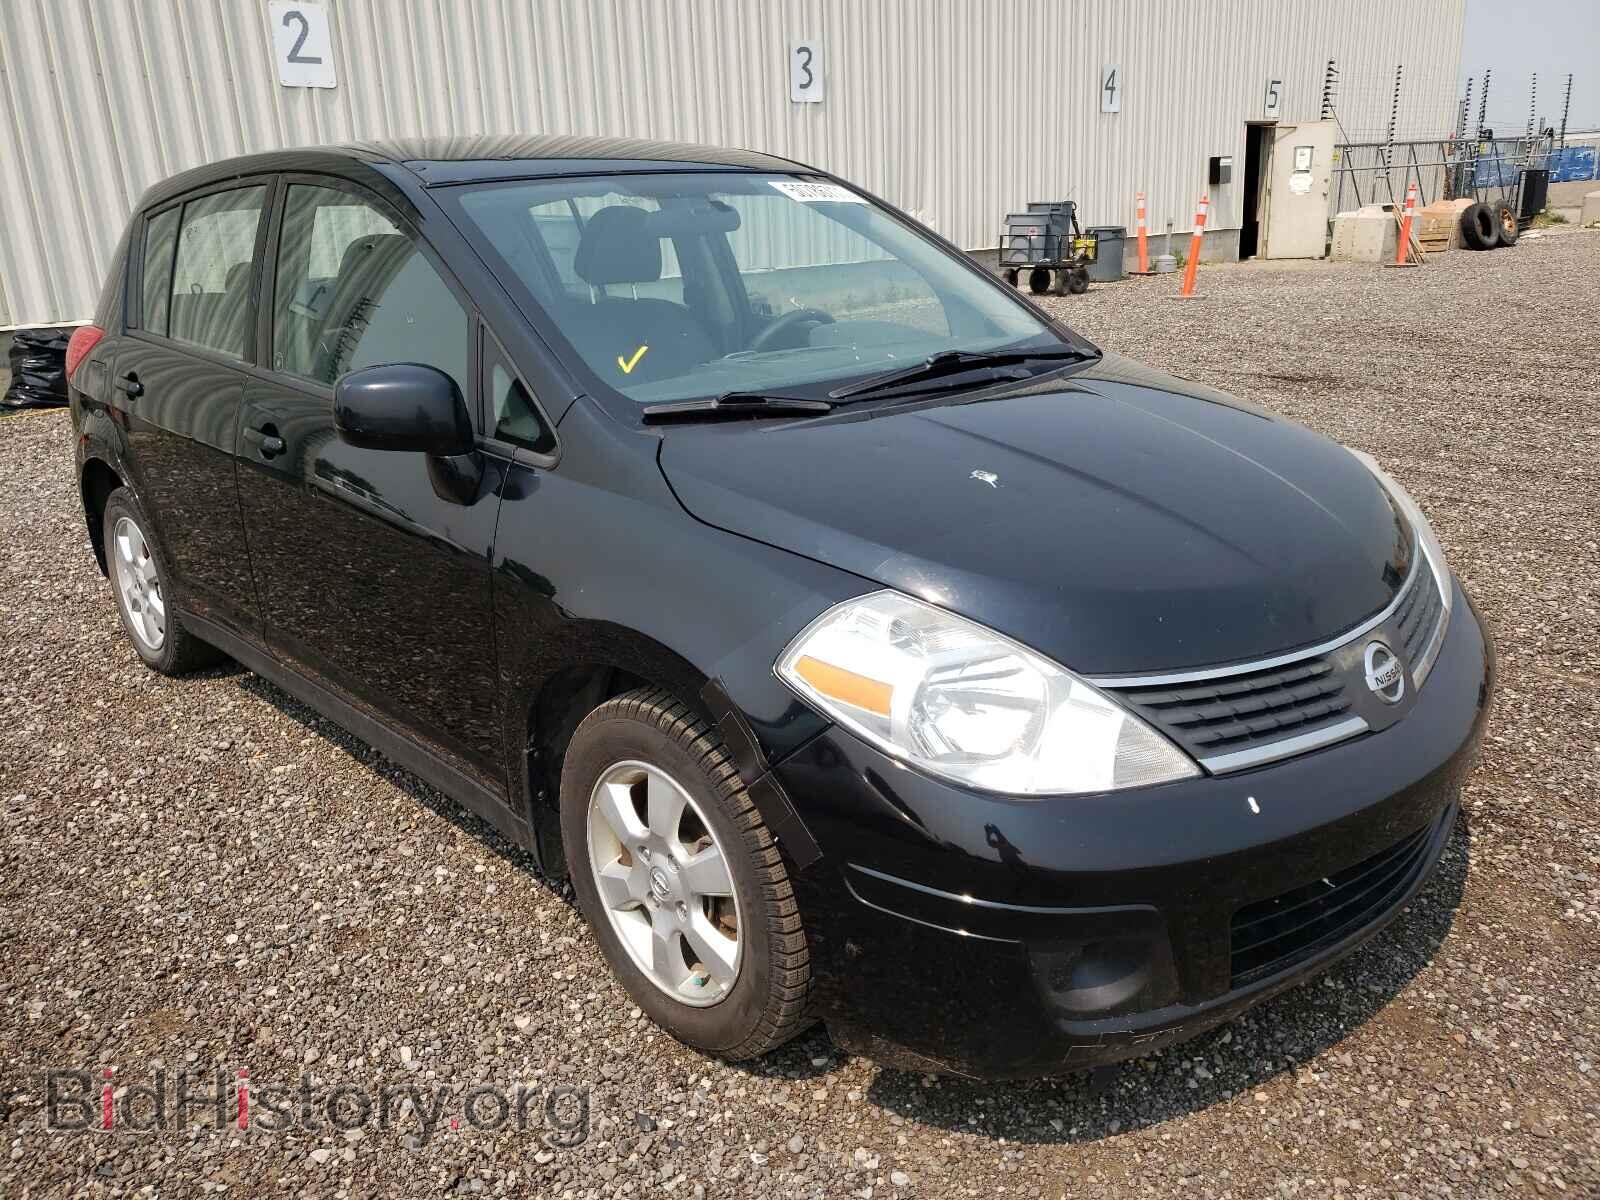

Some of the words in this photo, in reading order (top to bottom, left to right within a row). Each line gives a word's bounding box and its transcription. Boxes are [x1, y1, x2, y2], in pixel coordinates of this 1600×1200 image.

[282, 11, 322, 64] 2
[797, 46, 813, 89] 3
[1104, 69, 1116, 104] 4
[1267, 80, 1282, 108] 5
